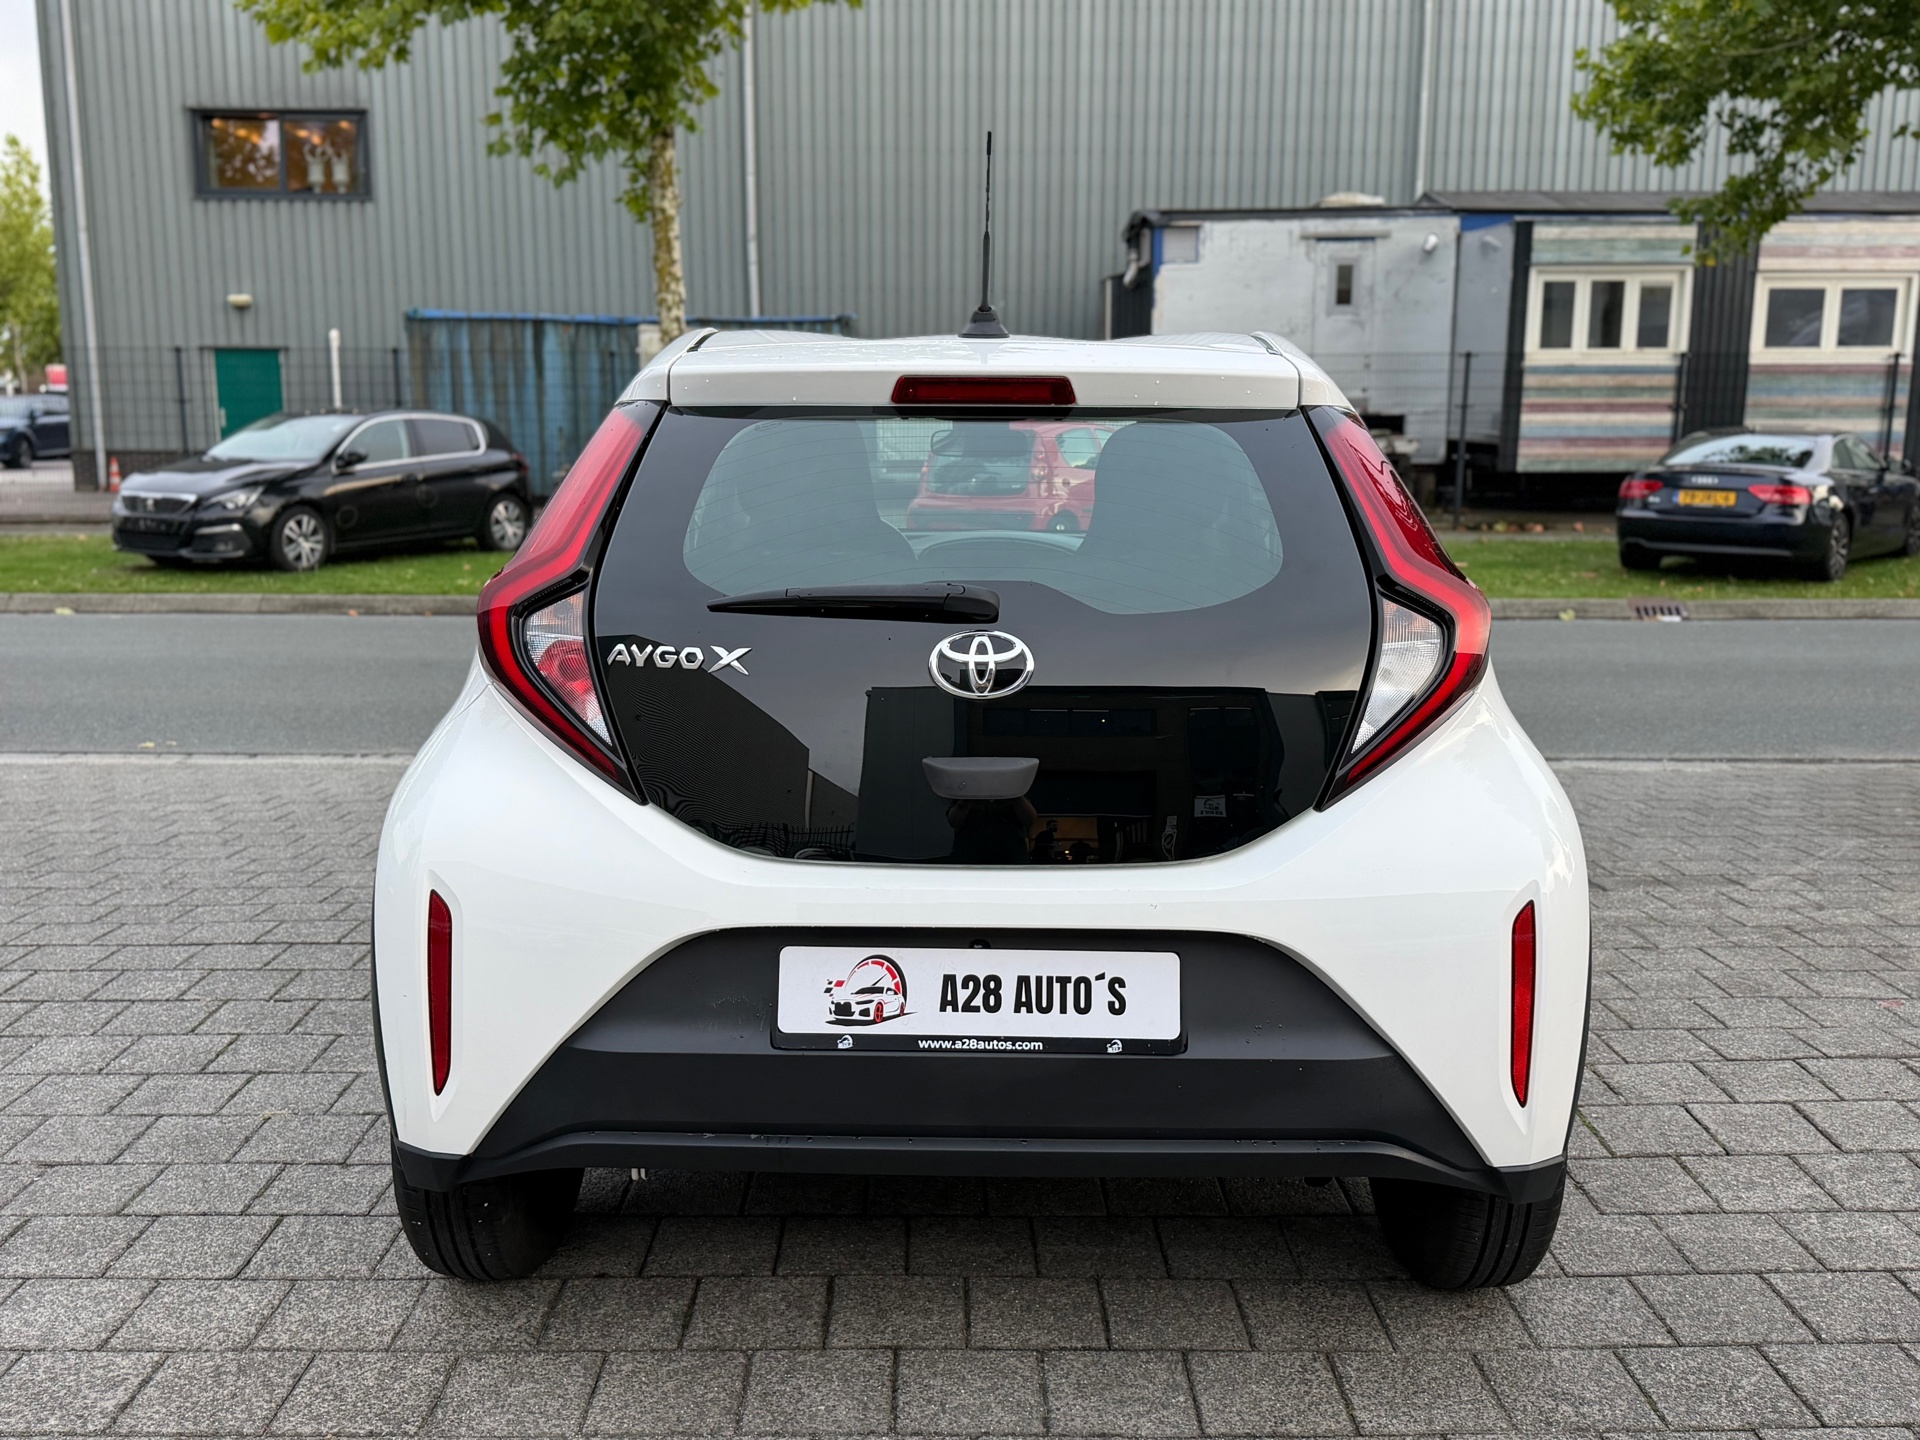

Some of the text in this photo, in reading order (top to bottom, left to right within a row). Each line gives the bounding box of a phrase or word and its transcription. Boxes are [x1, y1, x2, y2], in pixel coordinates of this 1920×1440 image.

[606, 643, 753, 676] AYGO X
[938, 973, 1003, 1014] A28
[917, 1038, 1044, 1052] www.a28autos.com
